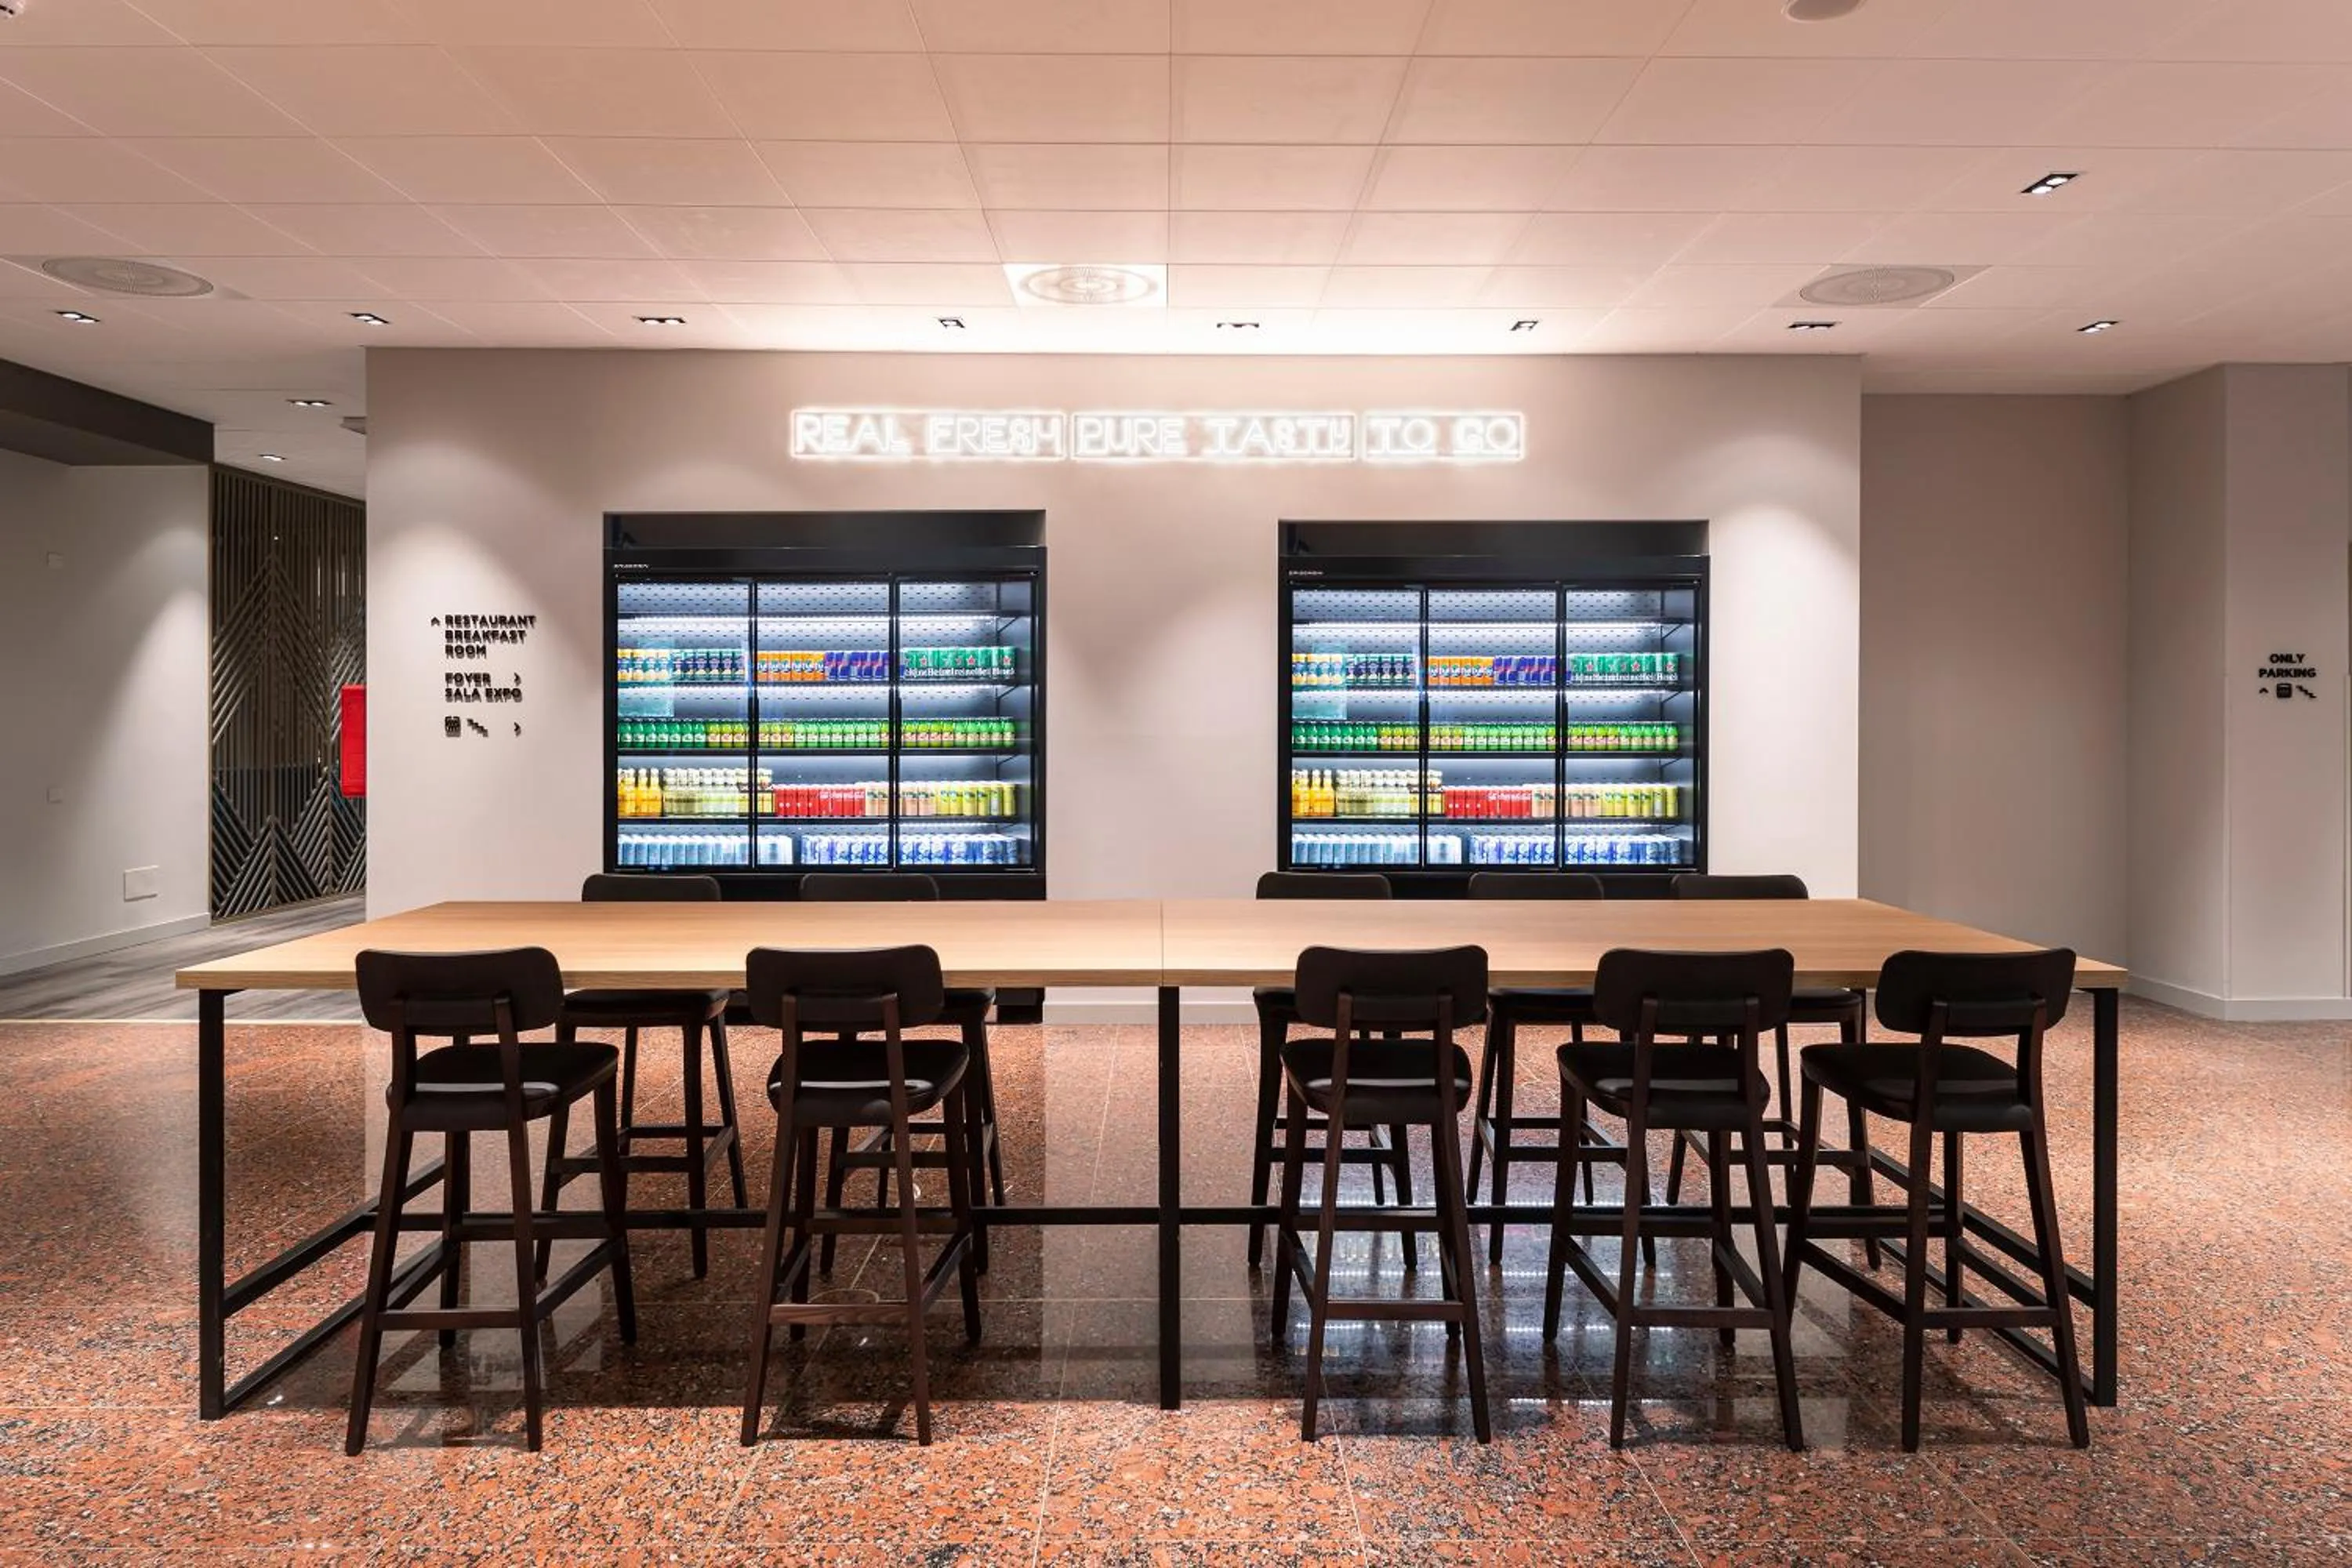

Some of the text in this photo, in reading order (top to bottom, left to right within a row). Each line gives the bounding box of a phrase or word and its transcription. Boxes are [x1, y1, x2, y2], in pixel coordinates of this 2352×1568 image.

[795, 415, 1061, 455] REAL FRESH
[1078, 417, 1185, 455] PURE
[1371, 418, 1518, 455] TO GO
[445, 615, 536, 627] RESTAURANT
[445, 630, 526, 642] BREAKFAST
[445, 644, 487, 657] ROOM
[2270, 653, 2306, 663] ONLY
[445, 673, 491, 685] FOYER
[2259, 668, 2317, 678] PARKING
[445, 688, 522, 701] SALA EXPO
